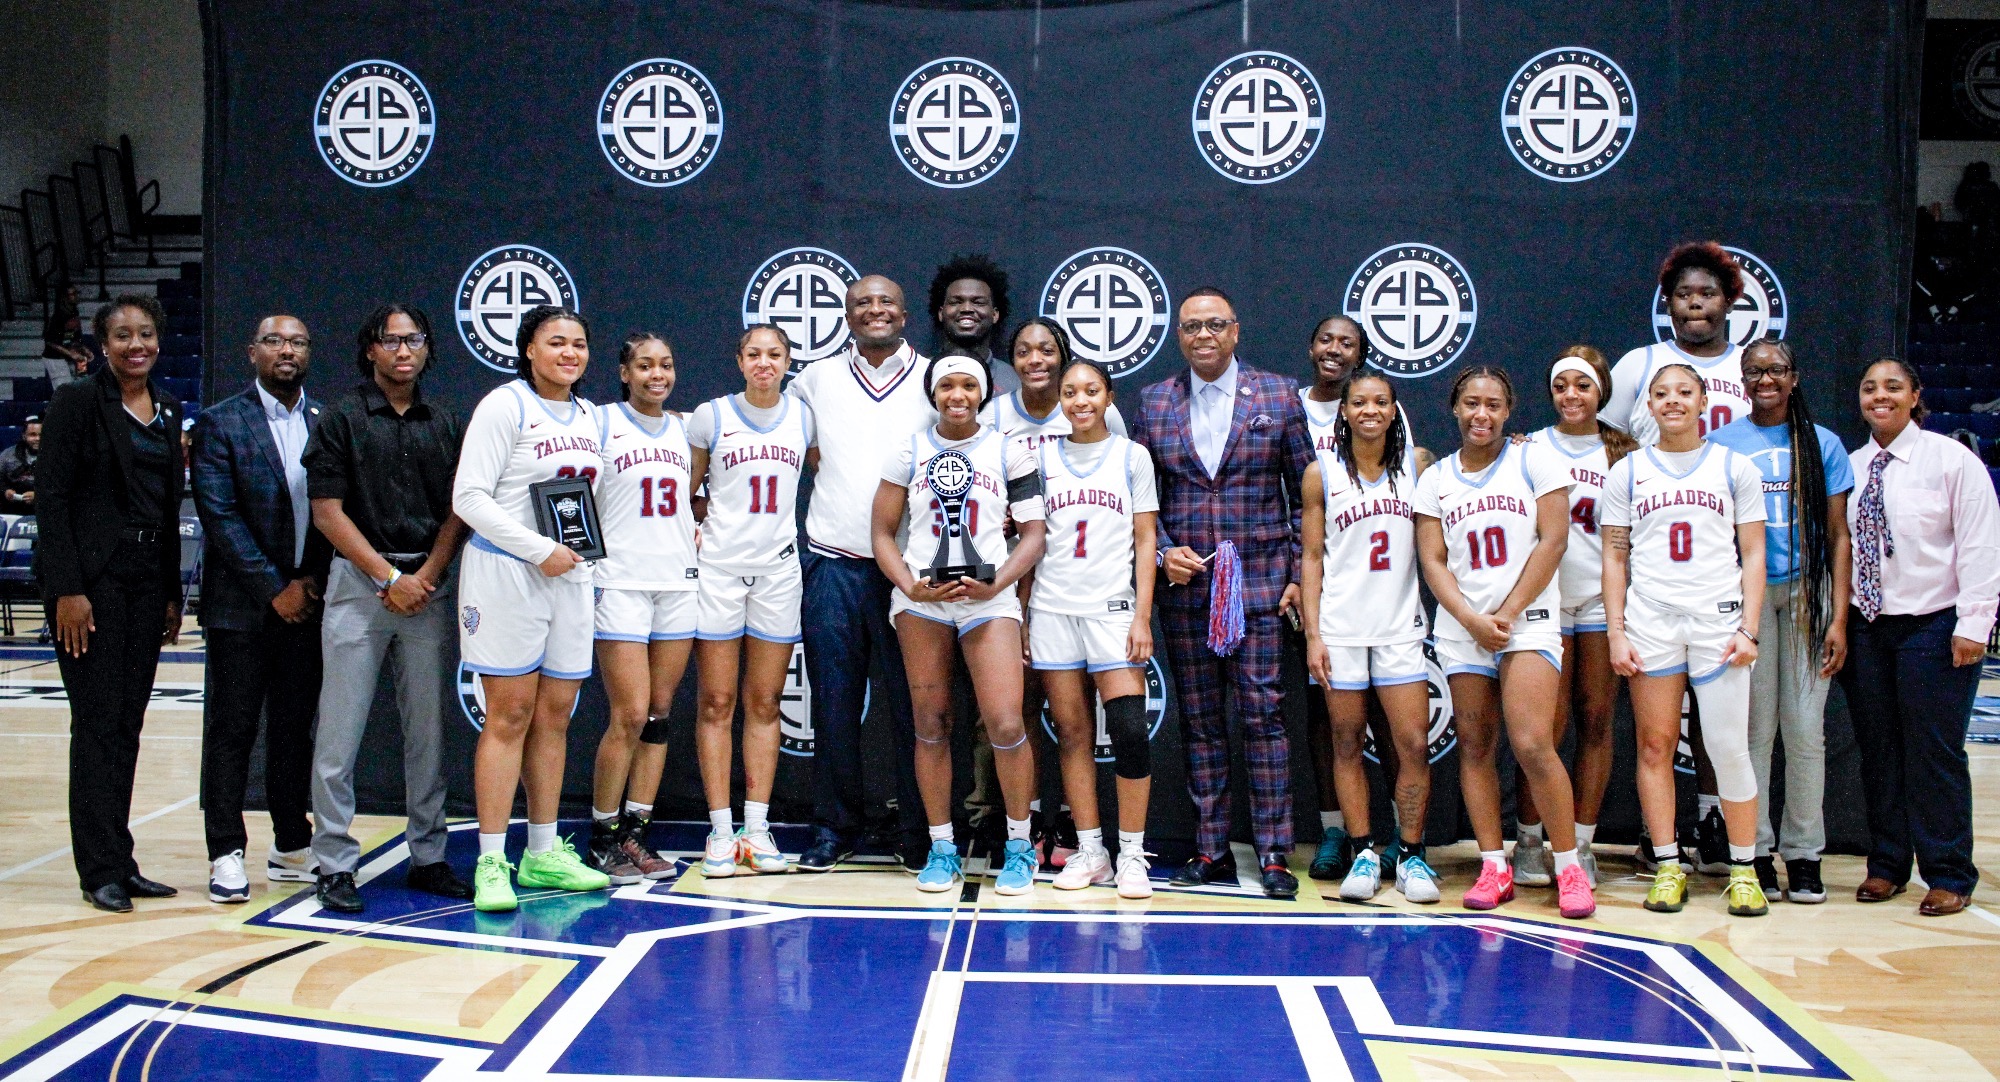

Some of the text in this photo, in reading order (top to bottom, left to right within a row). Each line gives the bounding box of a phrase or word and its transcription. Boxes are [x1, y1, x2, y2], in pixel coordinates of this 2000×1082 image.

[322, 66, 427, 114] HBCU ATHLETIC
[604, 64, 715, 112] HBCU ATHLETIC
[898, 64, 1012, 112] HBCU ATHLETIC
[1200, 58, 1318, 108] HBCU ATHLETIC
[1510, 54, 1628, 104] HBCU ATHLETIC
[328, 146, 422, 180] CONFERENCE
[610, 146, 710, 180] CONFERENCE
[904, 146, 1006, 180] CONFERENCE
[1206, 141, 1310, 176] CONFERENCE
[1516, 139, 1622, 174] CONFERENCE
[463, 251, 570, 298] HBCU ATHLETIC
[750, 254, 853, 301] HBCU ATHLET
[1048, 254, 1162, 302] HBCU ATHLETIC
[1352, 250, 1468, 299] HBCU ATHLETIC
[1732, 256, 1779, 306] HLETIC
[468, 332, 514, 366] CONFE
[1367, 336, 1462, 370] ONFERENCE
[534, 436, 602, 460] TALLADEG
[722, 445, 800, 472] TALLADEGA
[640, 476, 678, 518] 13
[748, 474, 778, 514] 11
[915, 471, 999, 496] TAEGA
[1046, 489, 1124, 516] TALLADEGA
[1445, 495, 1528, 533] TALLADEGA
[1636, 490, 1724, 521] TALLADEGA
[1073, 520, 1088, 559] 1
[1369, 530, 1392, 572] 2
[1467, 525, 1510, 570] 10
[1669, 521, 1693, 563] 0
